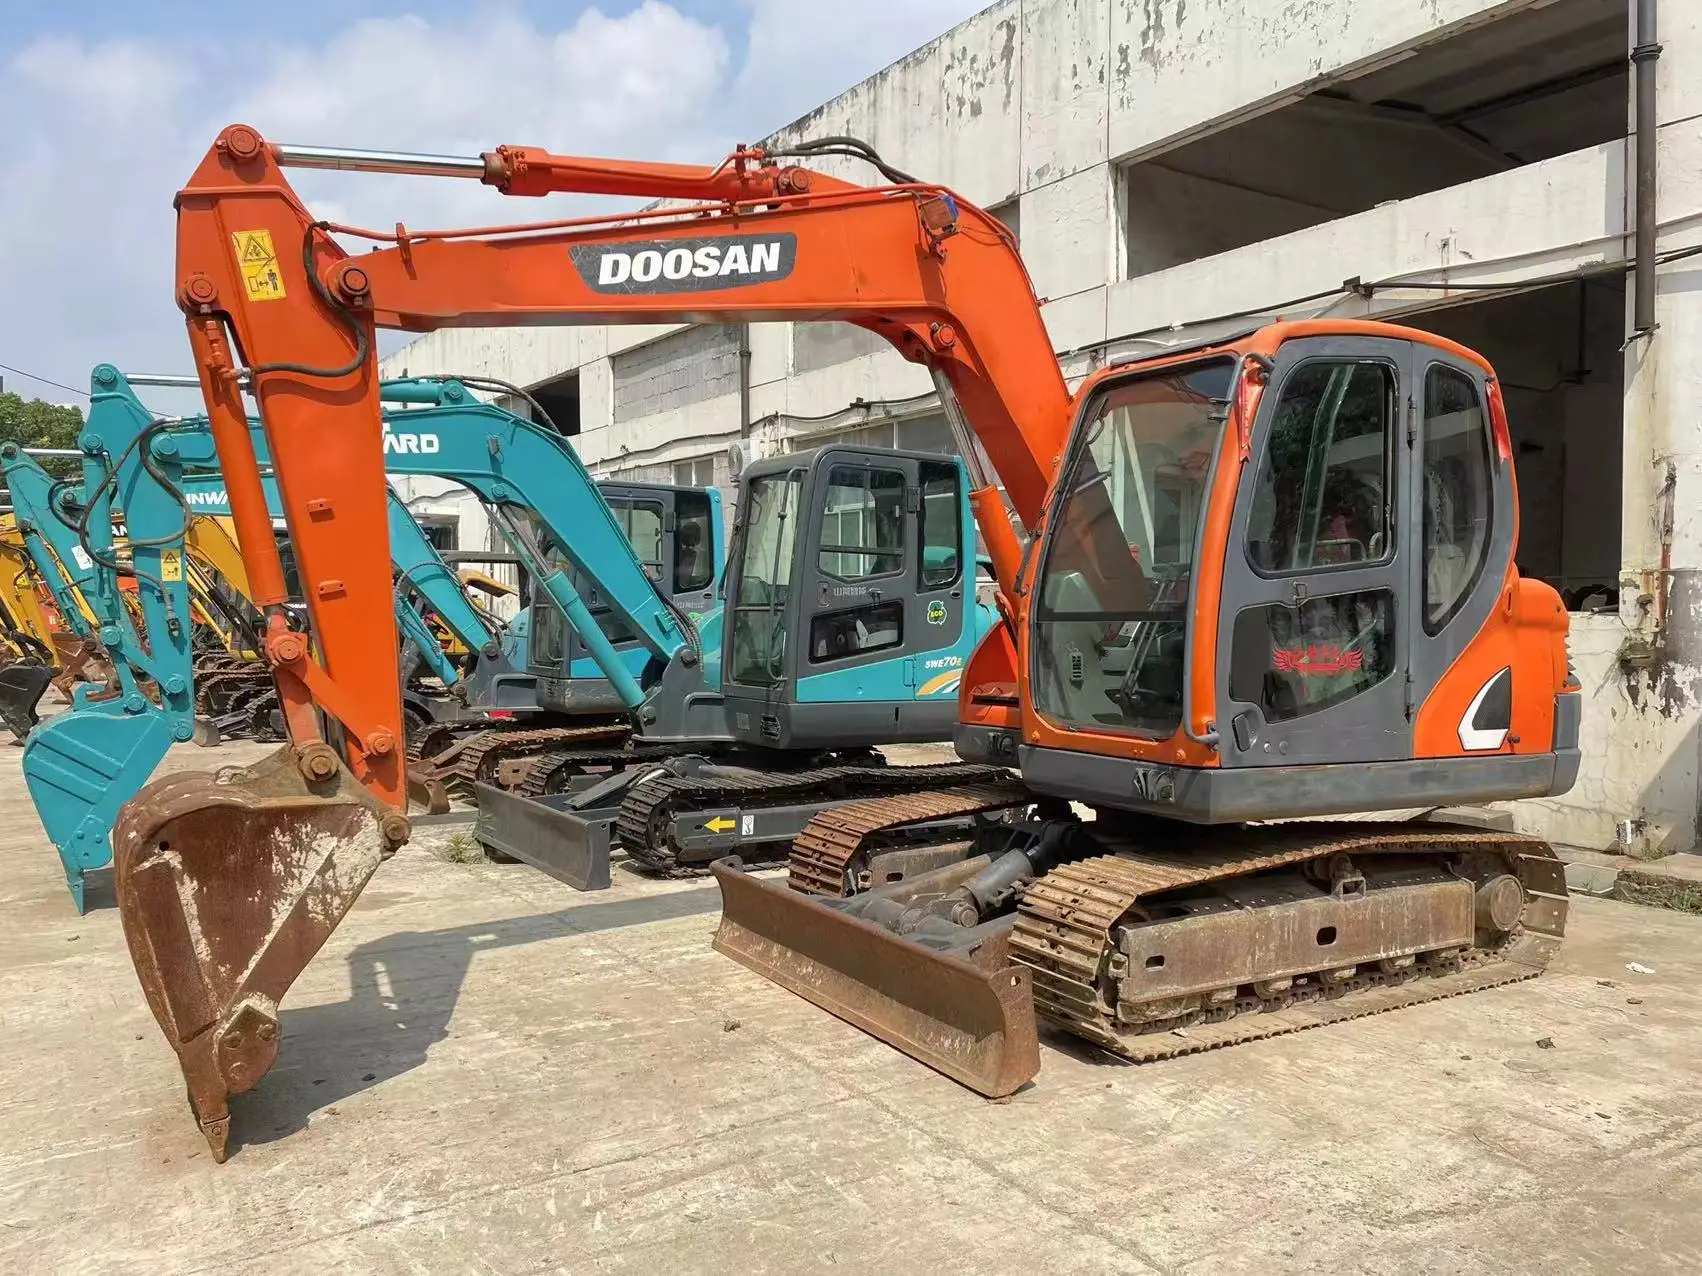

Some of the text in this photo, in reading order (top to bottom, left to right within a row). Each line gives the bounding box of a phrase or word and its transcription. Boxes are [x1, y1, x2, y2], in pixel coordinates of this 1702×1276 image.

[598, 242, 780, 285] DOOSAN
[382, 422, 440, 455] ARD
[930, 610, 944, 618] ECO
[924, 655, 963, 669] SWE70E
